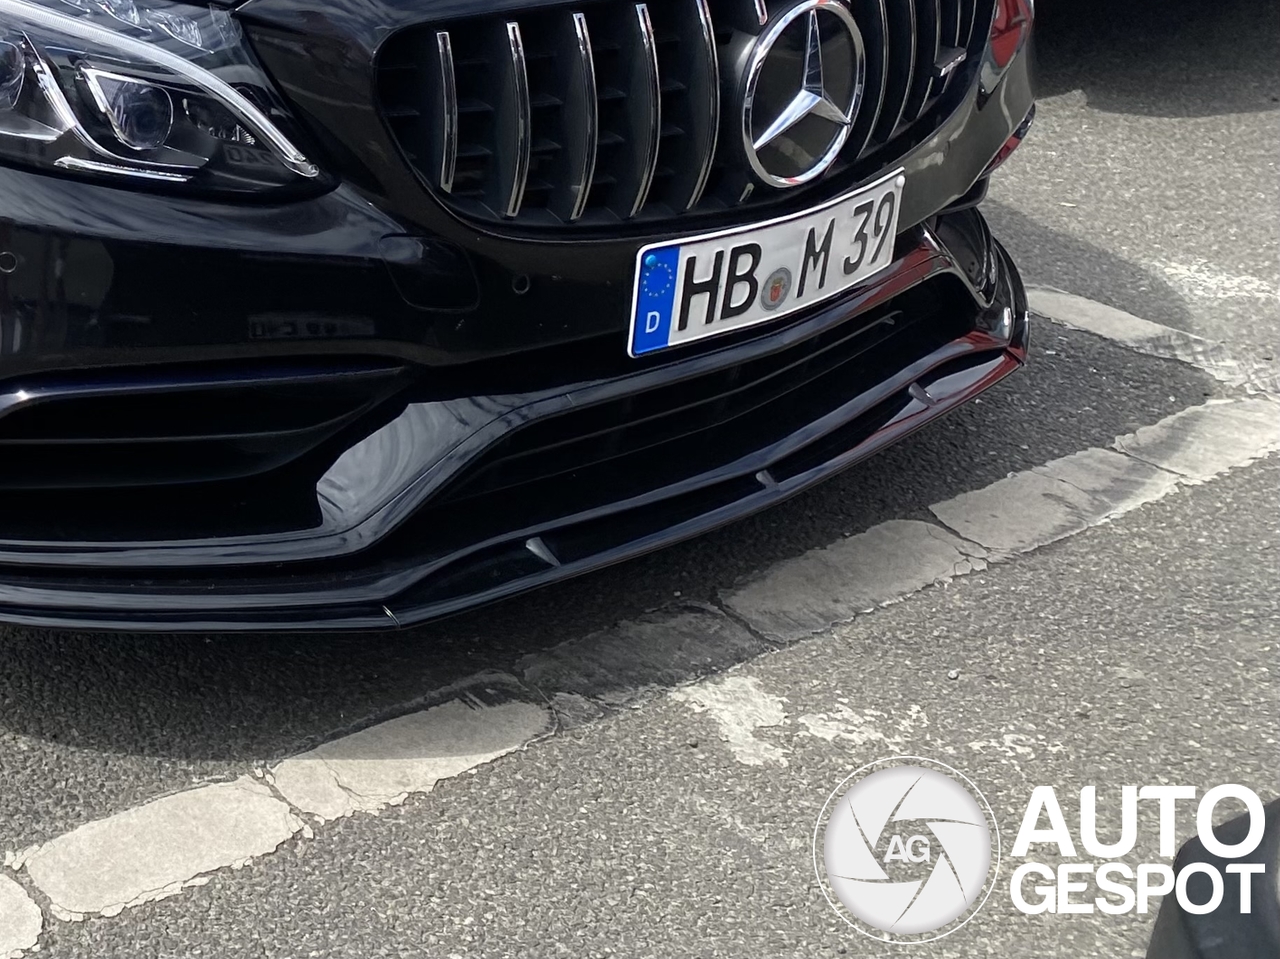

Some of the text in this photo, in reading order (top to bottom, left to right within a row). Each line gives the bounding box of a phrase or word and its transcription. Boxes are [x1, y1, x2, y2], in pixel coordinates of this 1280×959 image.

[677, 191, 895, 332] HB M 39
[645, 311, 660, 334] D
